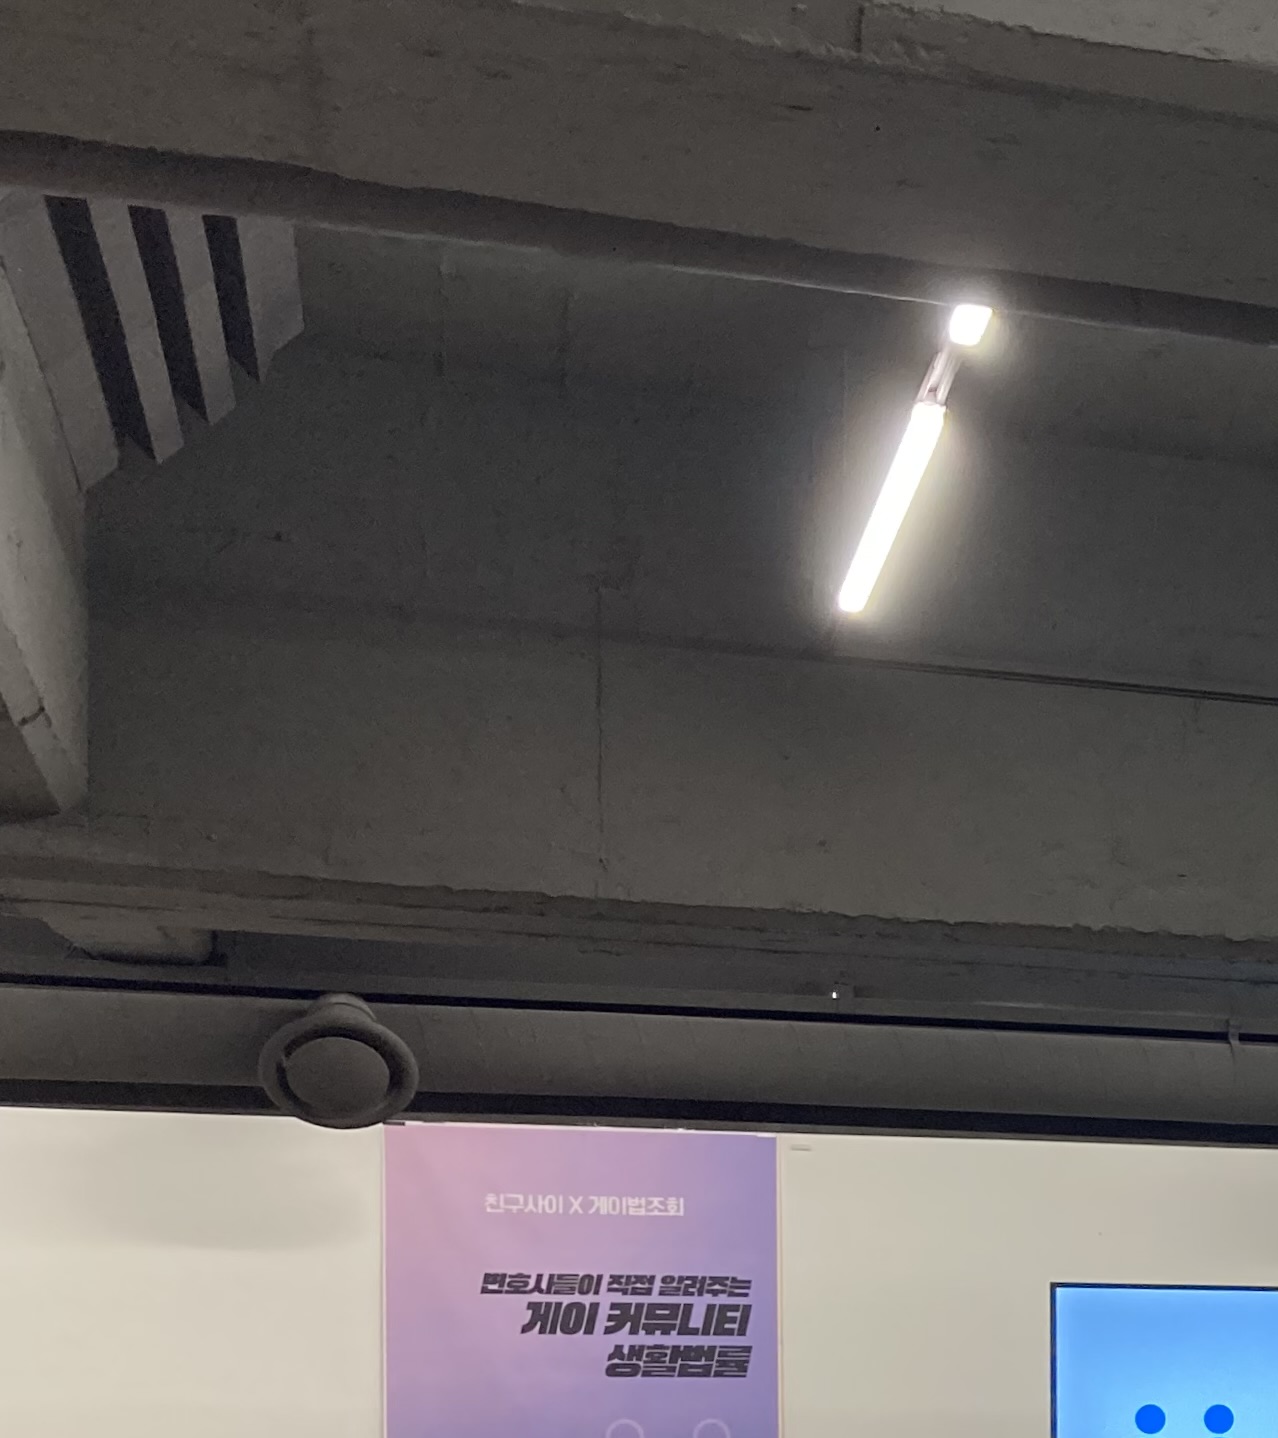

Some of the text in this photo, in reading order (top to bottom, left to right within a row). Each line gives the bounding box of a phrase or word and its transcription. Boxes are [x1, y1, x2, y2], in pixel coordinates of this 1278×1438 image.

[484, 1193, 684, 1216] 친구사이 X 게이법조회
[480, 1272, 752, 1298] 변호사들이 직접 알려주는
[520, 1301, 752, 1336] 게이 커뮤니티
[605, 1344, 753, 1378] 생활법률
